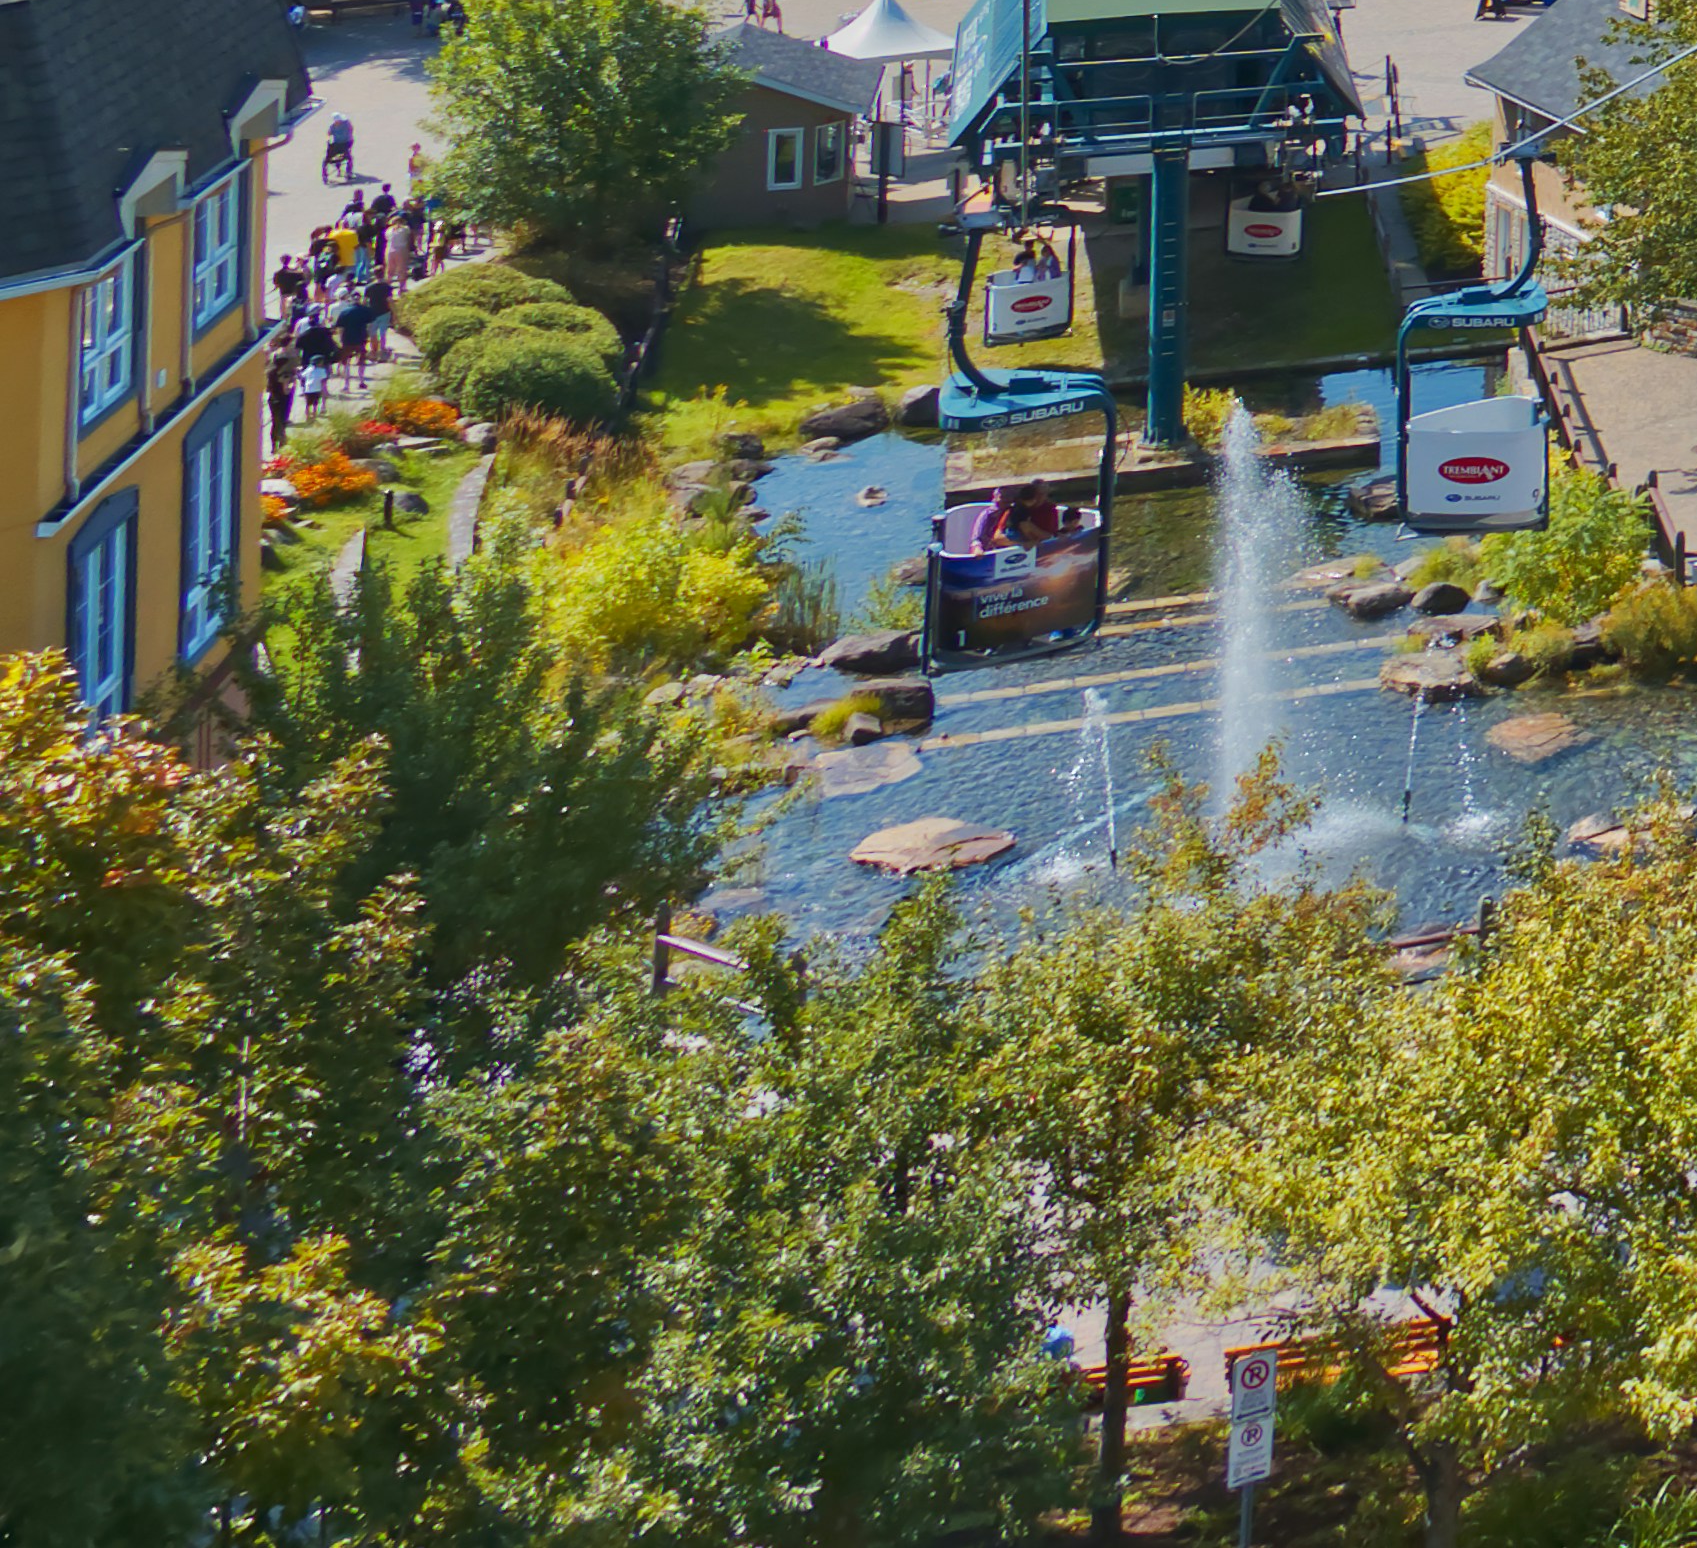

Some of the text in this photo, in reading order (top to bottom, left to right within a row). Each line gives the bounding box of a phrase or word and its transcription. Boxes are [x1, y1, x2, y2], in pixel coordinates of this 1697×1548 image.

[1452, 317, 1515, 327] SUBARU
[1009, 401, 1084, 424] SUBARU
[1443, 464, 1505, 481] TREMBLANT
[1011, 586, 1023, 598] la
[979, 595, 1049, 619] différence
[957, 630, 966, 647] 1
